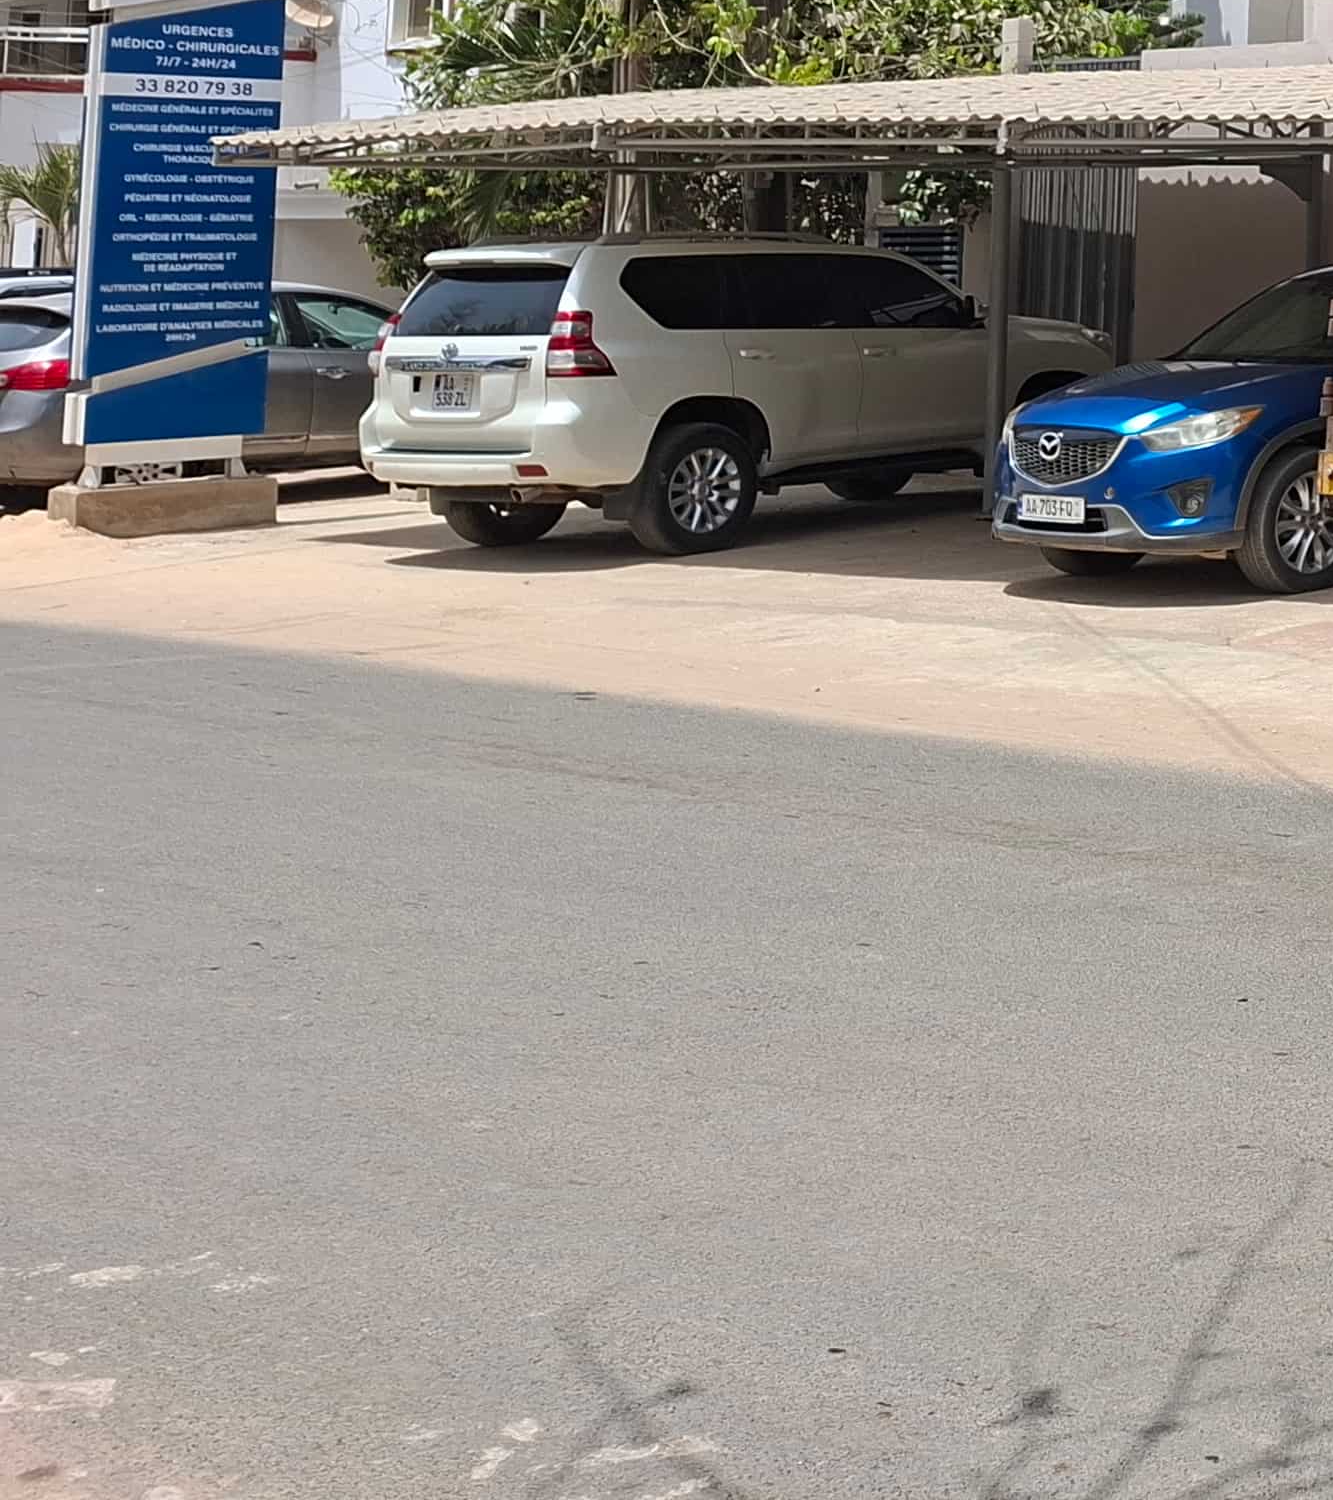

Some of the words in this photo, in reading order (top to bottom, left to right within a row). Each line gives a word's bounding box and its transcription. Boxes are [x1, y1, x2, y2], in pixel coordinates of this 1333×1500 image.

[162, 24, 233, 39] URGENCES
[111, 36, 166, 50] MÉDICO
[176, 41, 280, 56] CHIRURGICALES
[155, 56, 182, 67] 7J/7
[191, 58, 236, 69] 24H/24
[135, 79, 158, 93] 33
[164, 80, 199, 94] 820
[204, 81, 225, 95] 79
[230, 83, 252, 96] 38
[111, 102, 159, 113] MÉDECINE
[160, 103, 206, 115] GÉNÉRALE
[208, 106, 219, 115] ET
[109, 124, 158, 133] CHIRURGIE
[160, 122, 206, 133] GÉNÉRALE
[208, 124, 219, 133] ET
[133, 143, 182, 153] CHIRURGIE
[124, 172, 187, 183] GYNÉCOLOGIE
[124, 192, 170, 202] PÉDIATRIE
[171, 193, 182, 202] ET
[171, 233, 183, 241] ET
[225, 252, 237, 260] ET
[143, 264, 155, 272] DE
[100, 284, 149, 293] NUTRITION
[150, 283, 162, 292] ET
[163, 281, 209, 291] MÉDECINE
[211, 281, 264, 291] PRÉVENTIVE
[102, 303, 157, 312] RADIOLOGIE
[159, 302, 171, 311] ET
[216, 300, 260, 310] MÉDICALE
[96, 323, 158, 333] LABORATOIRE
